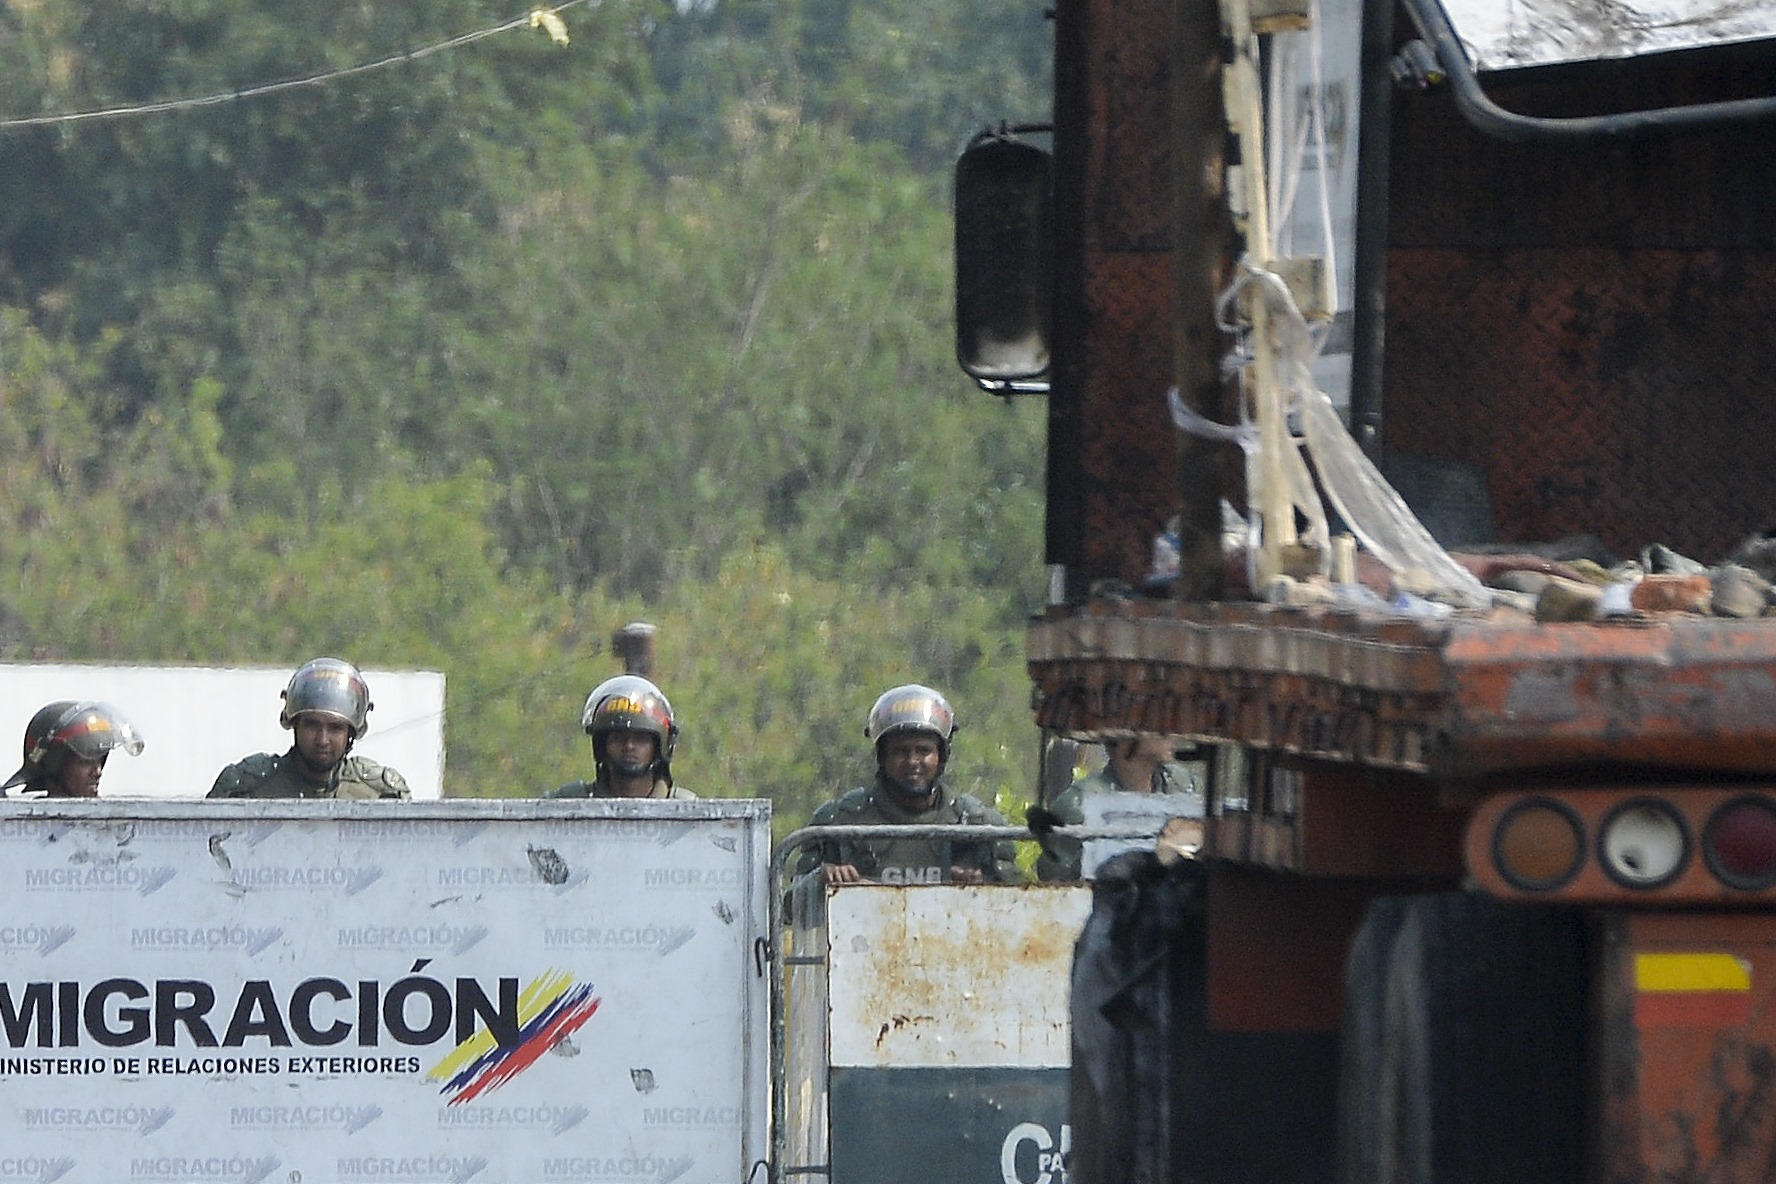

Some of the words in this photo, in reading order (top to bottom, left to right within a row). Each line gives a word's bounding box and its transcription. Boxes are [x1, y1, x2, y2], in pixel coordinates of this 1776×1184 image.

[131, 923, 260, 945] MIGRACIÓN
[338, 922, 467, 945] MIGRACIÓN
[544, 923, 673, 945] MIGRACIÓN
[114, 1058, 140, 1075] DE
[147, 1057, 279, 1075] RELACIONES
[288, 1056, 420, 1074] EXTERIORES
[25, 1103, 154, 1126] MIGRACIÓN
[231, 1103, 360, 1126] MIGRACIÓN
[437, 1102, 566, 1125] MIGRACIÓN
[130, 1153, 260, 1175] MIGRACIÓN
[337, 1152, 467, 1175] MIGRACIÓN
[543, 1154, 672, 1175] MIGRACIÓN
